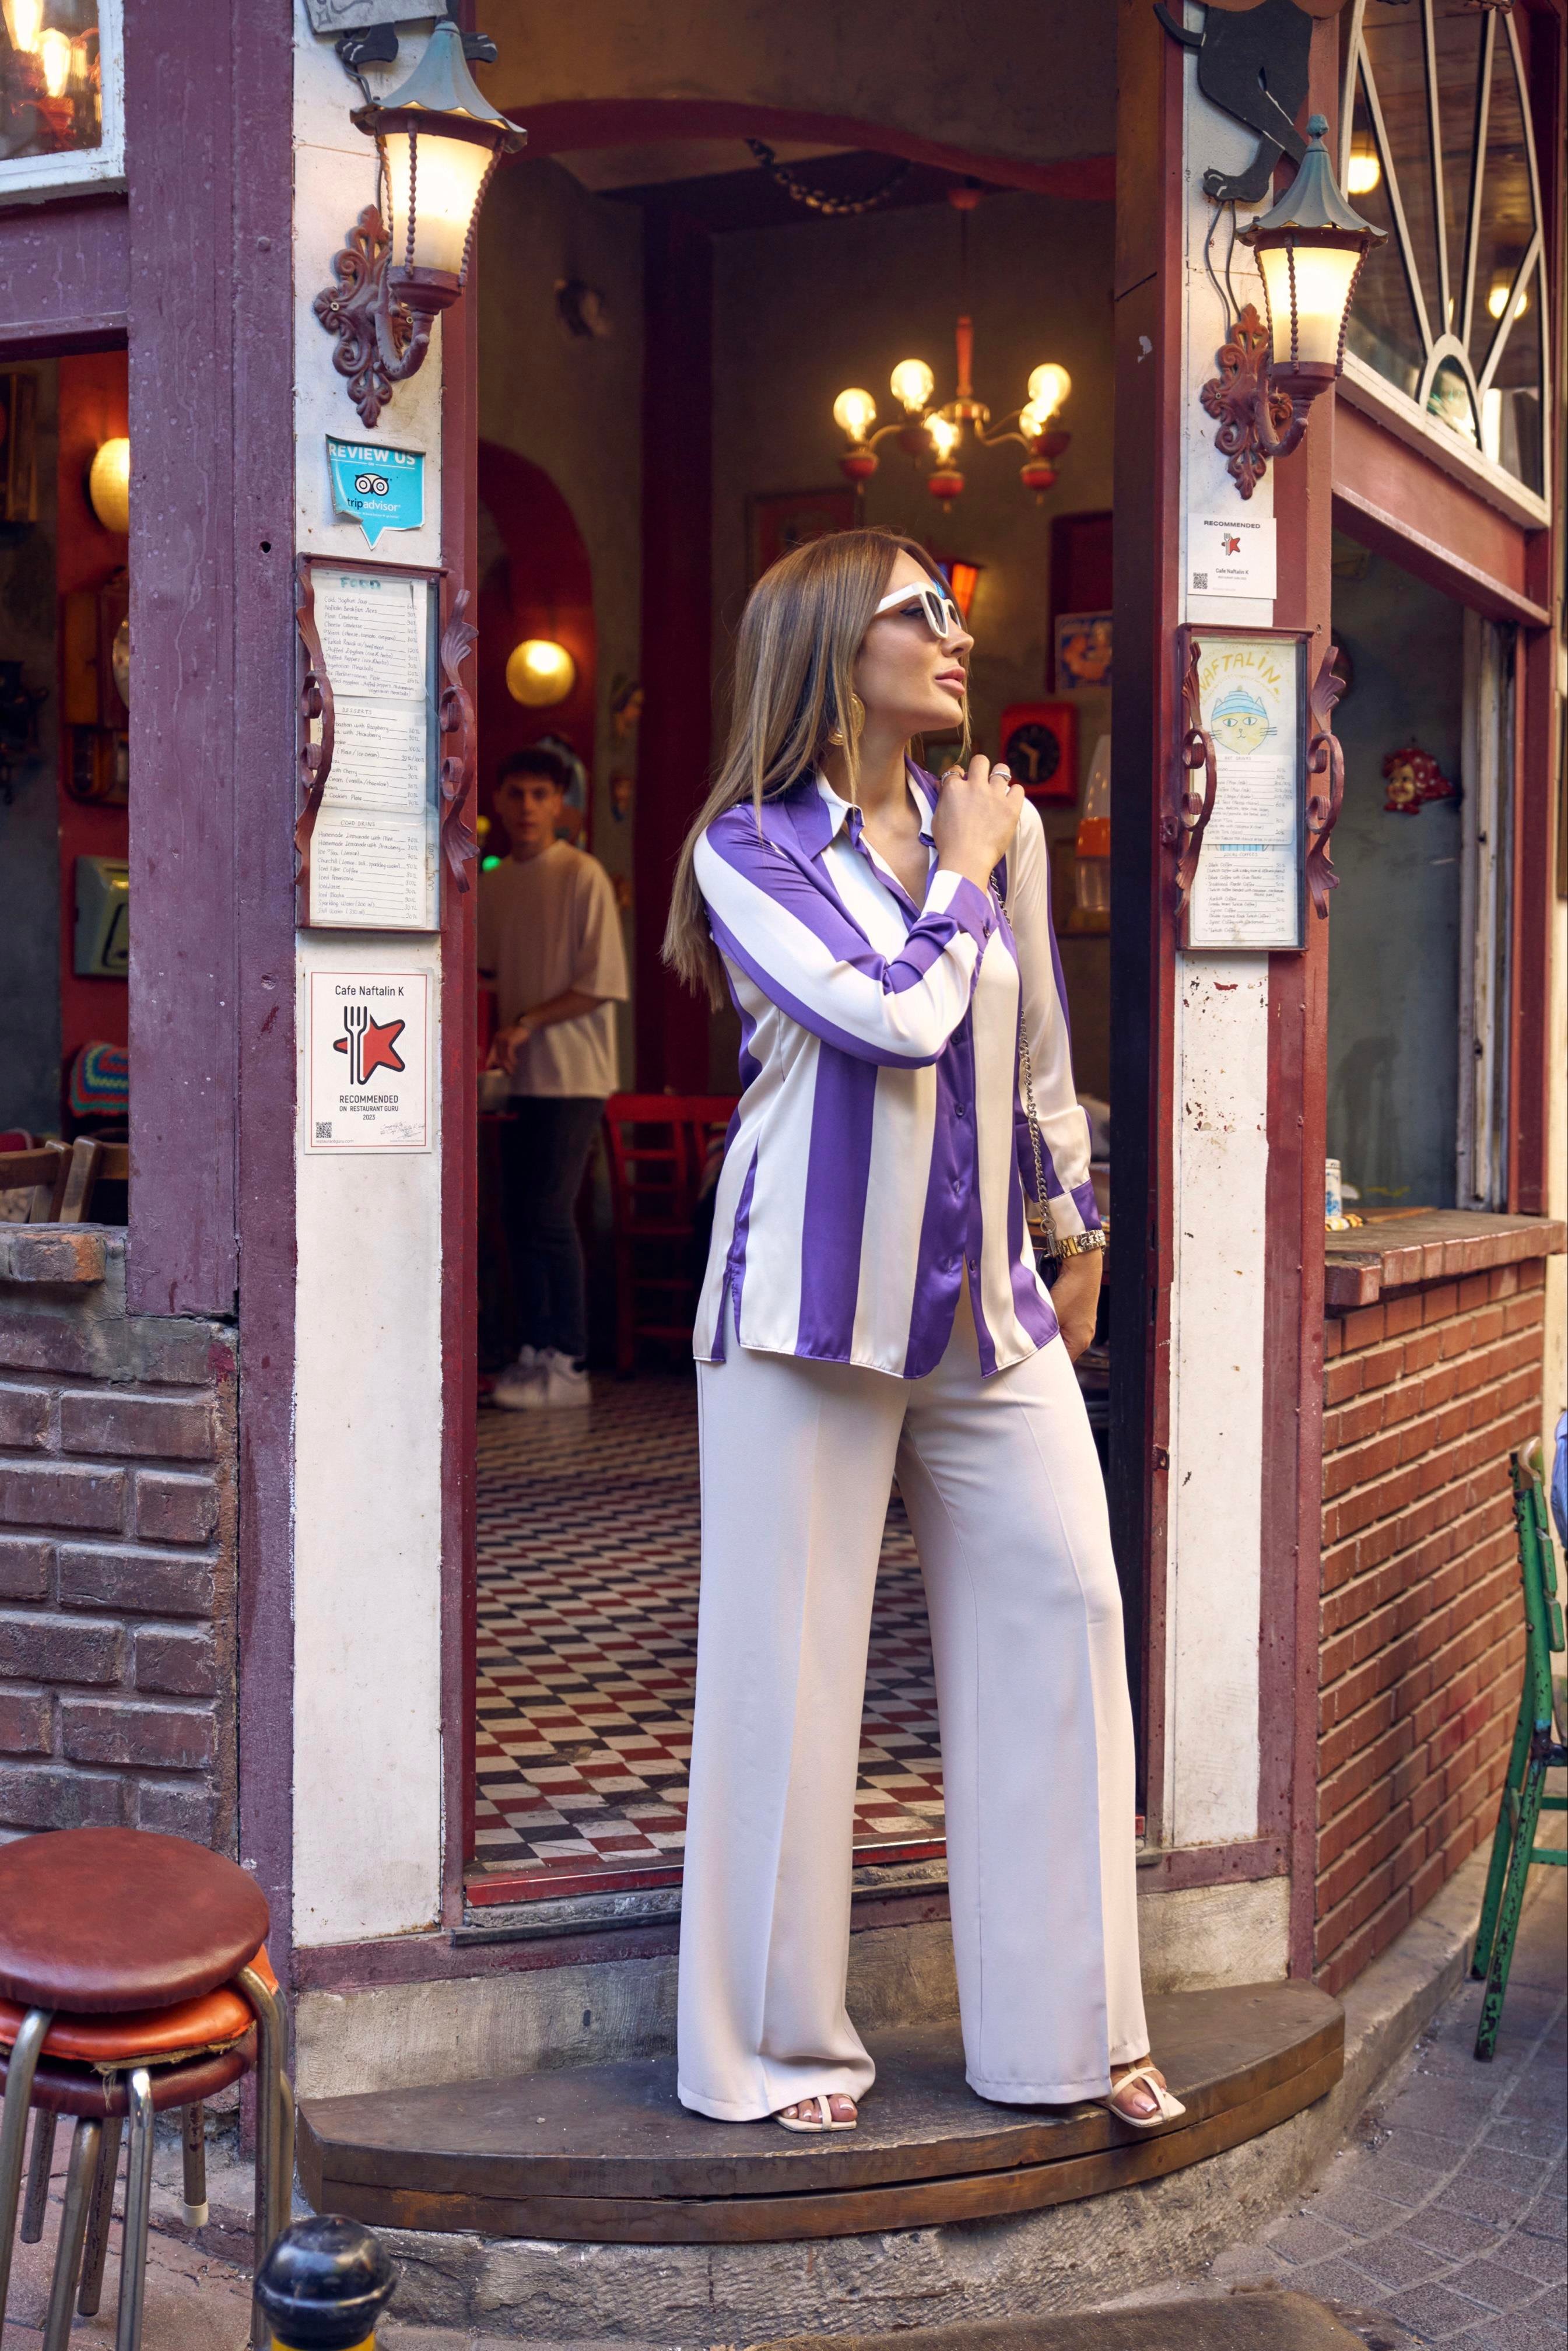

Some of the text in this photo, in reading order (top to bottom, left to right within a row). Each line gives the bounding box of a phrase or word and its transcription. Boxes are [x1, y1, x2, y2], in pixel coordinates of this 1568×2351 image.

[328, 443, 416, 465] REVIEW US
[347, 498, 398, 511] tripadvisor
[1204, 520, 1261, 529] RECOMMENDED
[367, 724, 389, 732] Raspberry
[355, 731, 381, 740] Strawberry
[343, 866, 359, 875] Coffee
[335, 985, 404, 996] Cafe Naftalin K
[339, 1094, 398, 1103] RECOMMENDED
